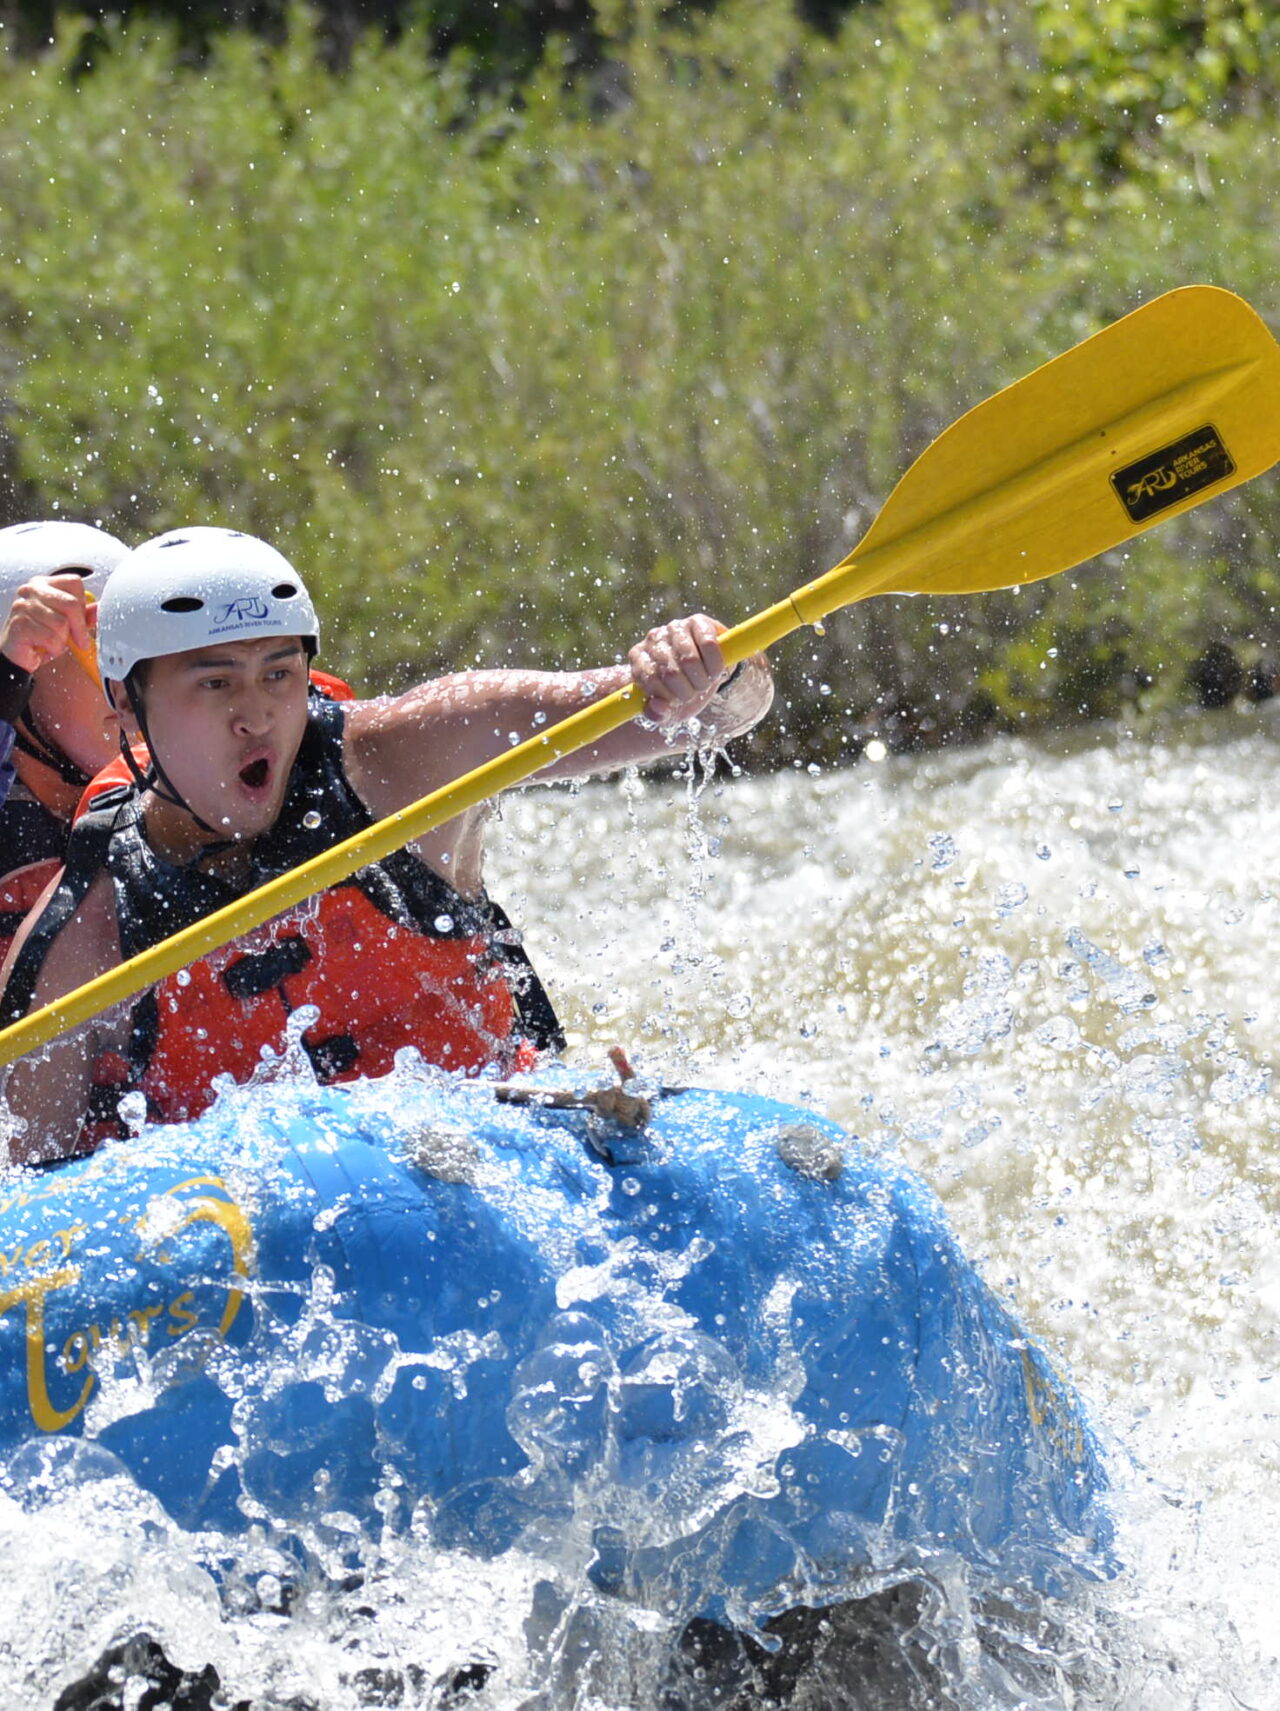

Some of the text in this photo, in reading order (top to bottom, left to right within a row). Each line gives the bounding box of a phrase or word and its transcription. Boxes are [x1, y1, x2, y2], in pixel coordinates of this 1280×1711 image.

[1173, 439, 1217, 467] ARKANSAS
[1175, 457, 1200, 473] RIVER
[1179, 461, 1208, 480] TOURS
